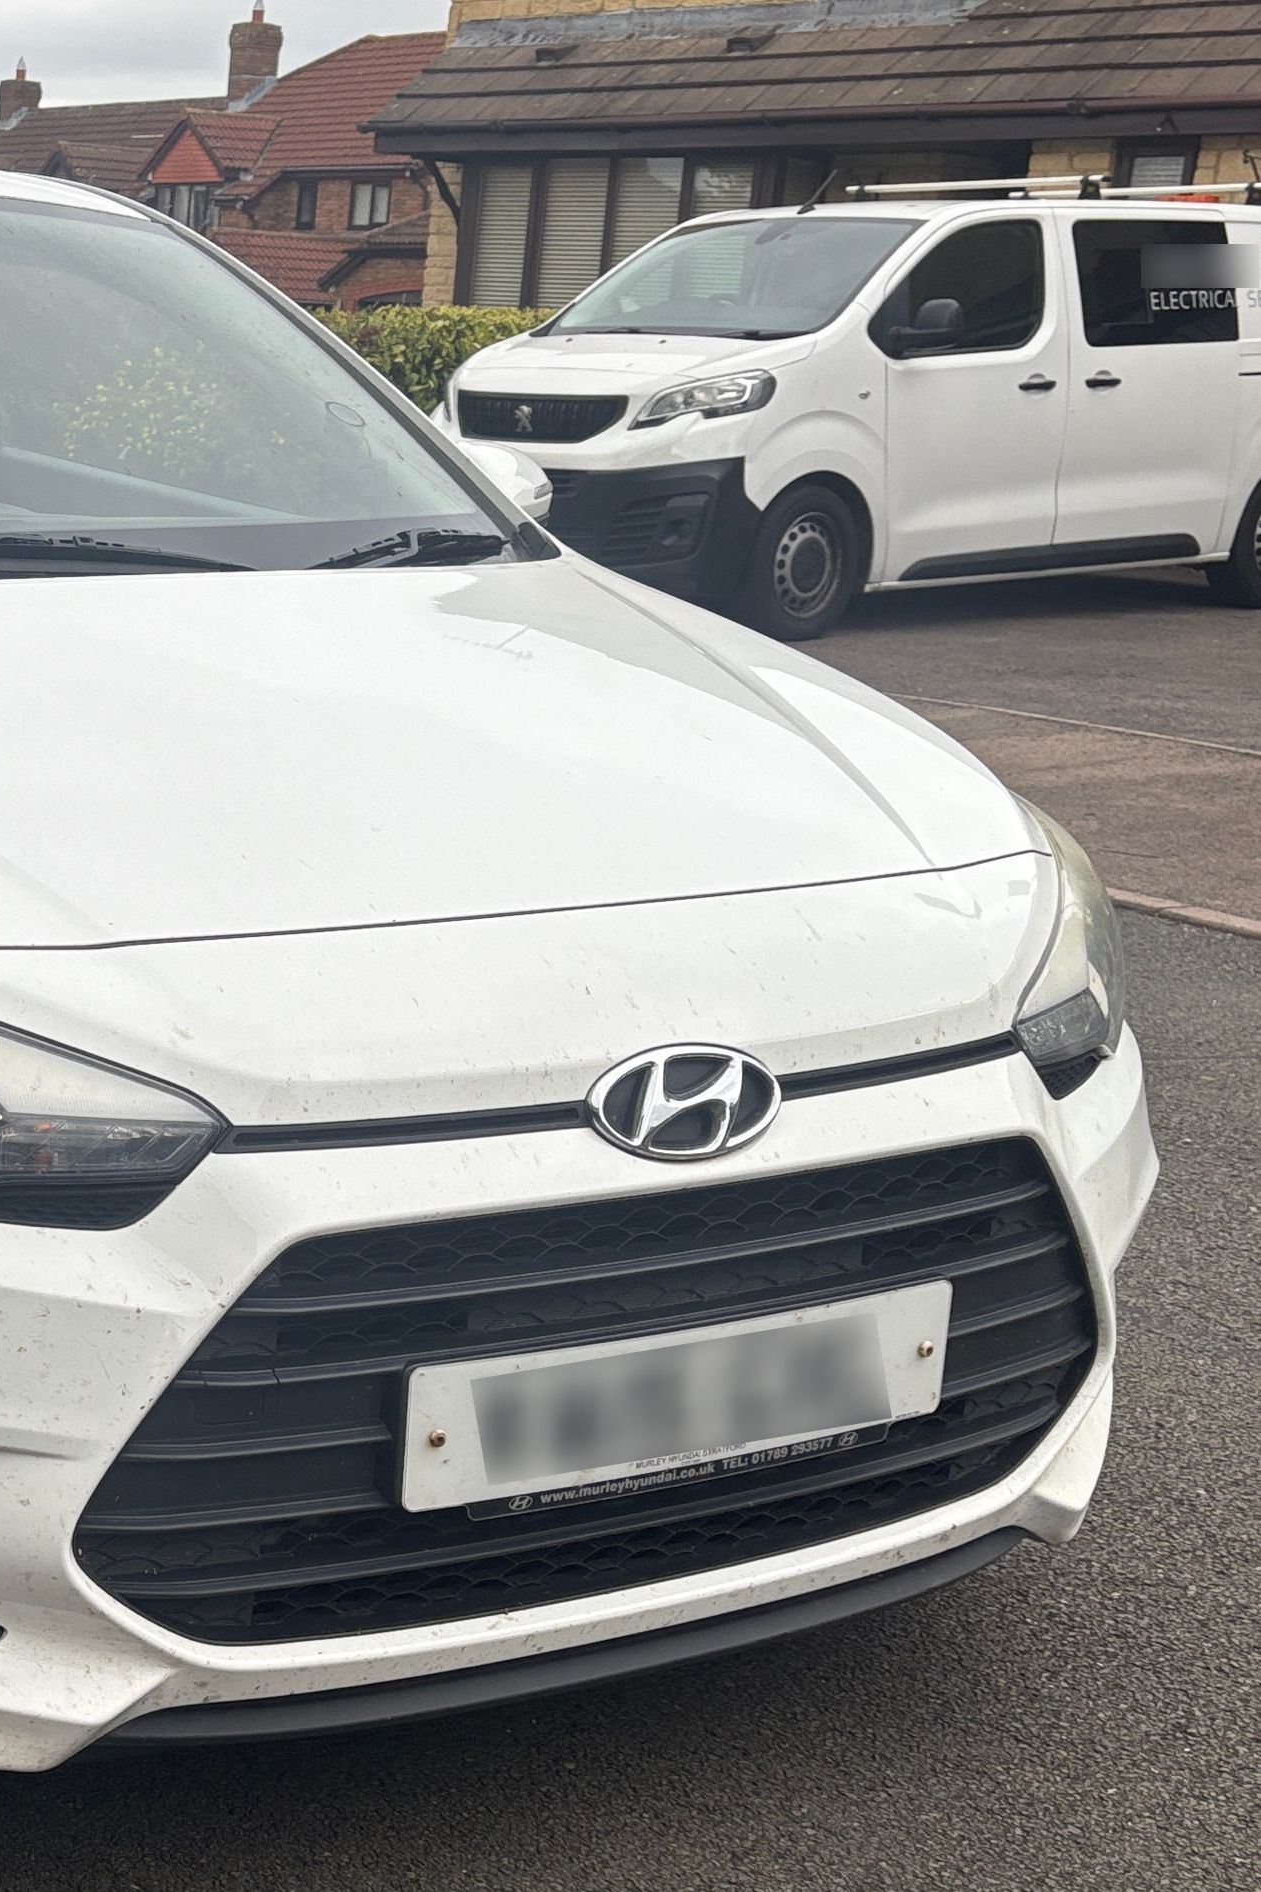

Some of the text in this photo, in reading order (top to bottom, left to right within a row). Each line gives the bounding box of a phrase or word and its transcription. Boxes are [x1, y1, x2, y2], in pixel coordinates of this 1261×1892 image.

[539, 1463, 716, 1504] www.murleyhyundai.co.uk
[722, 1456, 749, 1470] TEL:
[751, 1447, 789, 1465] 01789
[791, 1437, 835, 1456] 293577
[635, 1457, 667, 1469] MURLEY
[668, 1449, 701, 1464] HYUNDAI
